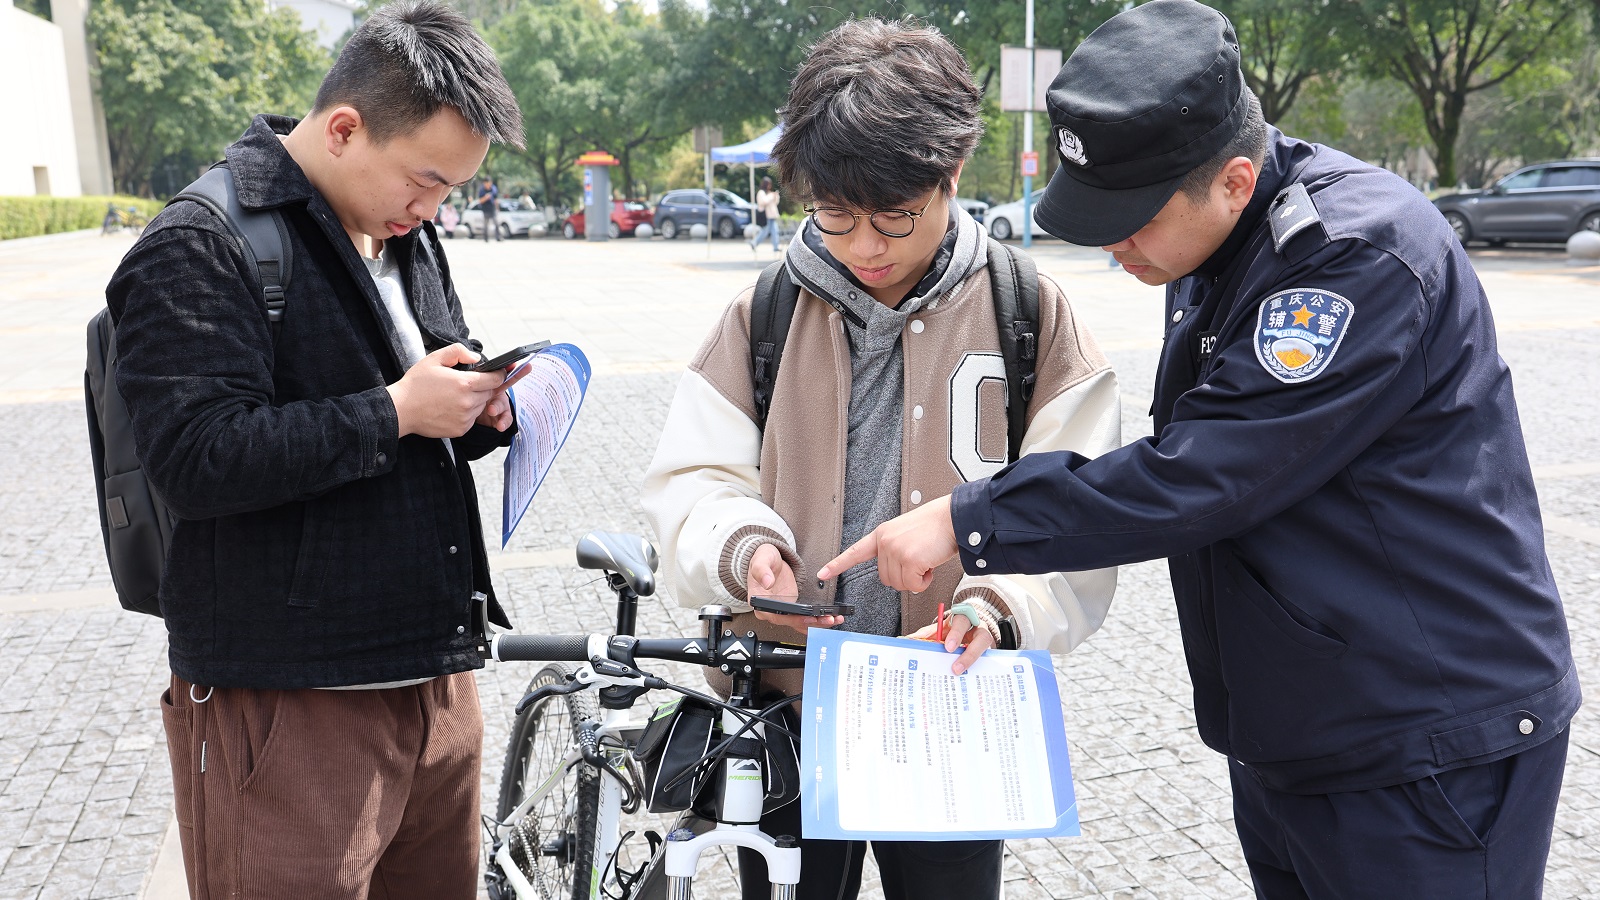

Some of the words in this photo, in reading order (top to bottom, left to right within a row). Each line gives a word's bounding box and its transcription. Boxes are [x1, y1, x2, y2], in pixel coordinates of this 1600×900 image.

[1269, 293, 1346, 317] 重庆公安
[1296, 331, 1315, 342] JING
